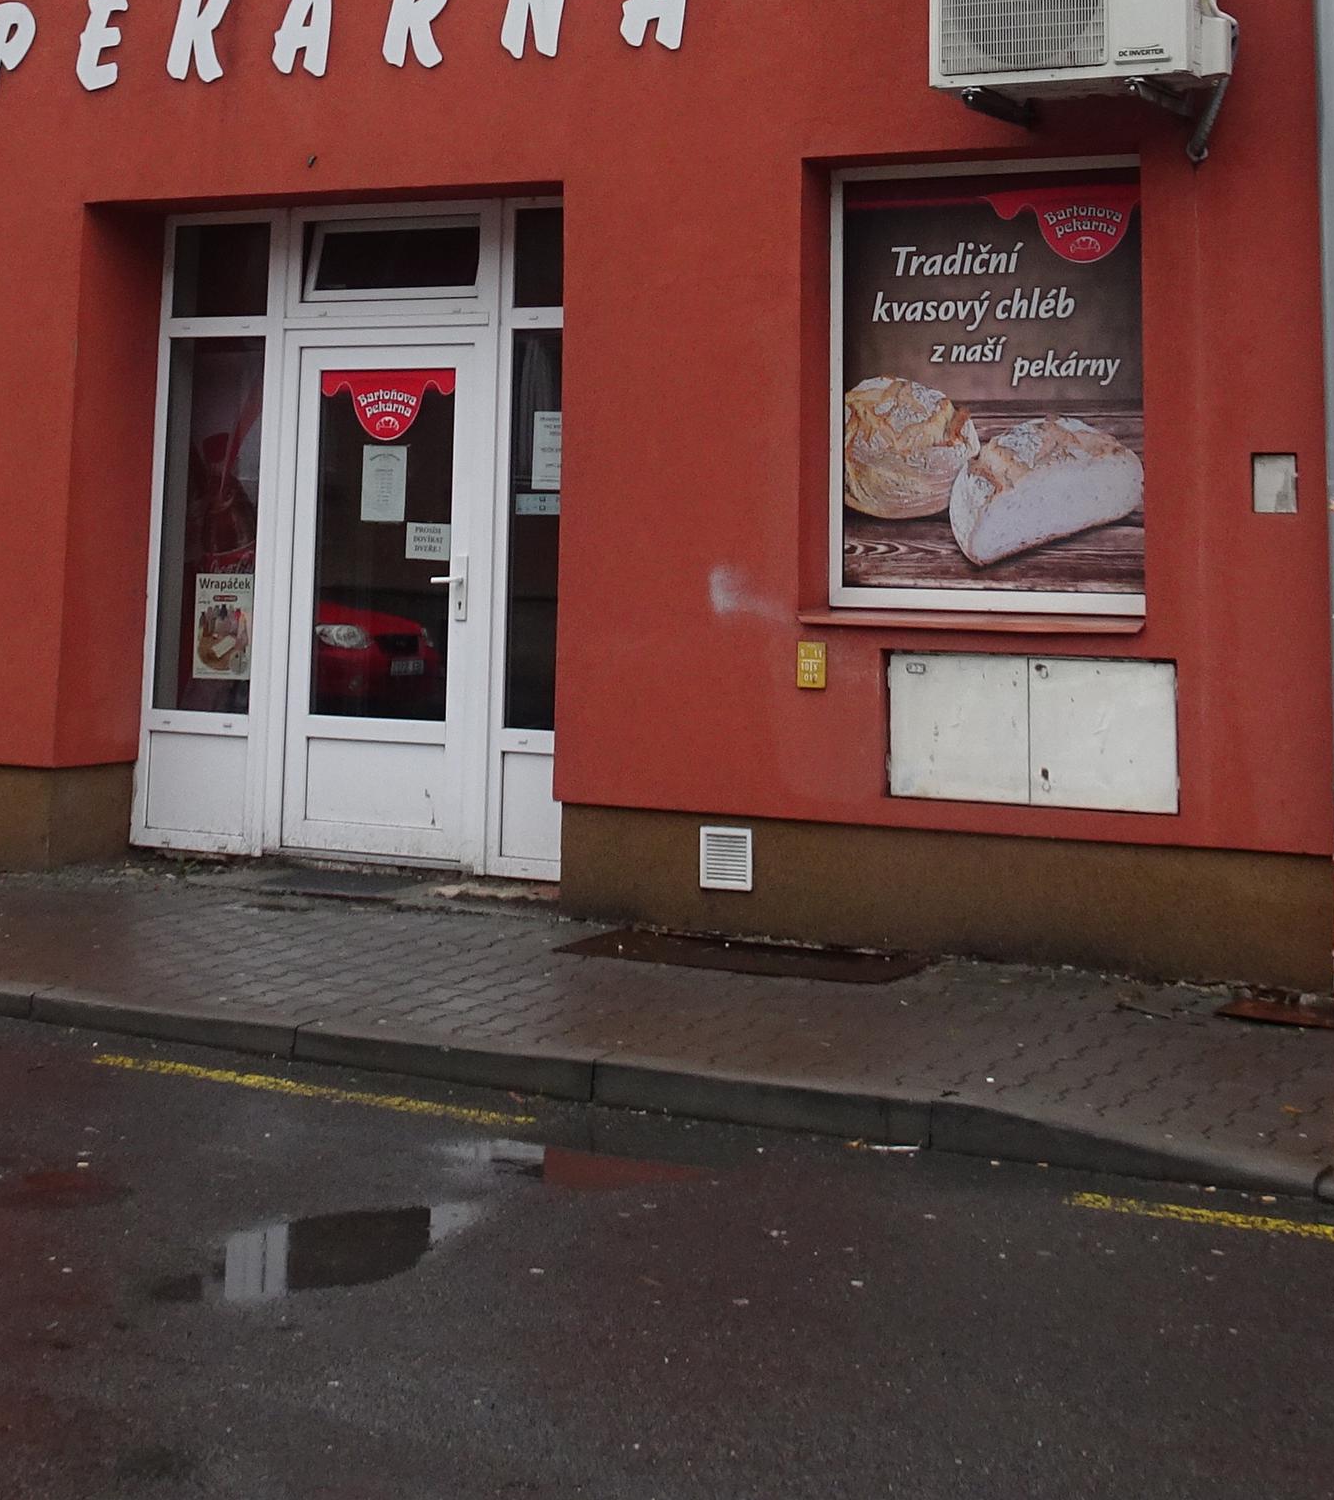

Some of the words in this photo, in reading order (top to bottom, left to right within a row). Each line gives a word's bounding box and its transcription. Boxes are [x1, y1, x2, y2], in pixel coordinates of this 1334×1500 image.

[891, 242, 1024, 277] Tradiční
[872, 291, 991, 331] kvasový
[994, 286, 1076, 320] chléb
[930, 344, 945, 363] z
[949, 336, 1008, 363] naší
[1011, 350, 1121, 387] pekárny
[198, 577, 252, 592] Wrapáček
